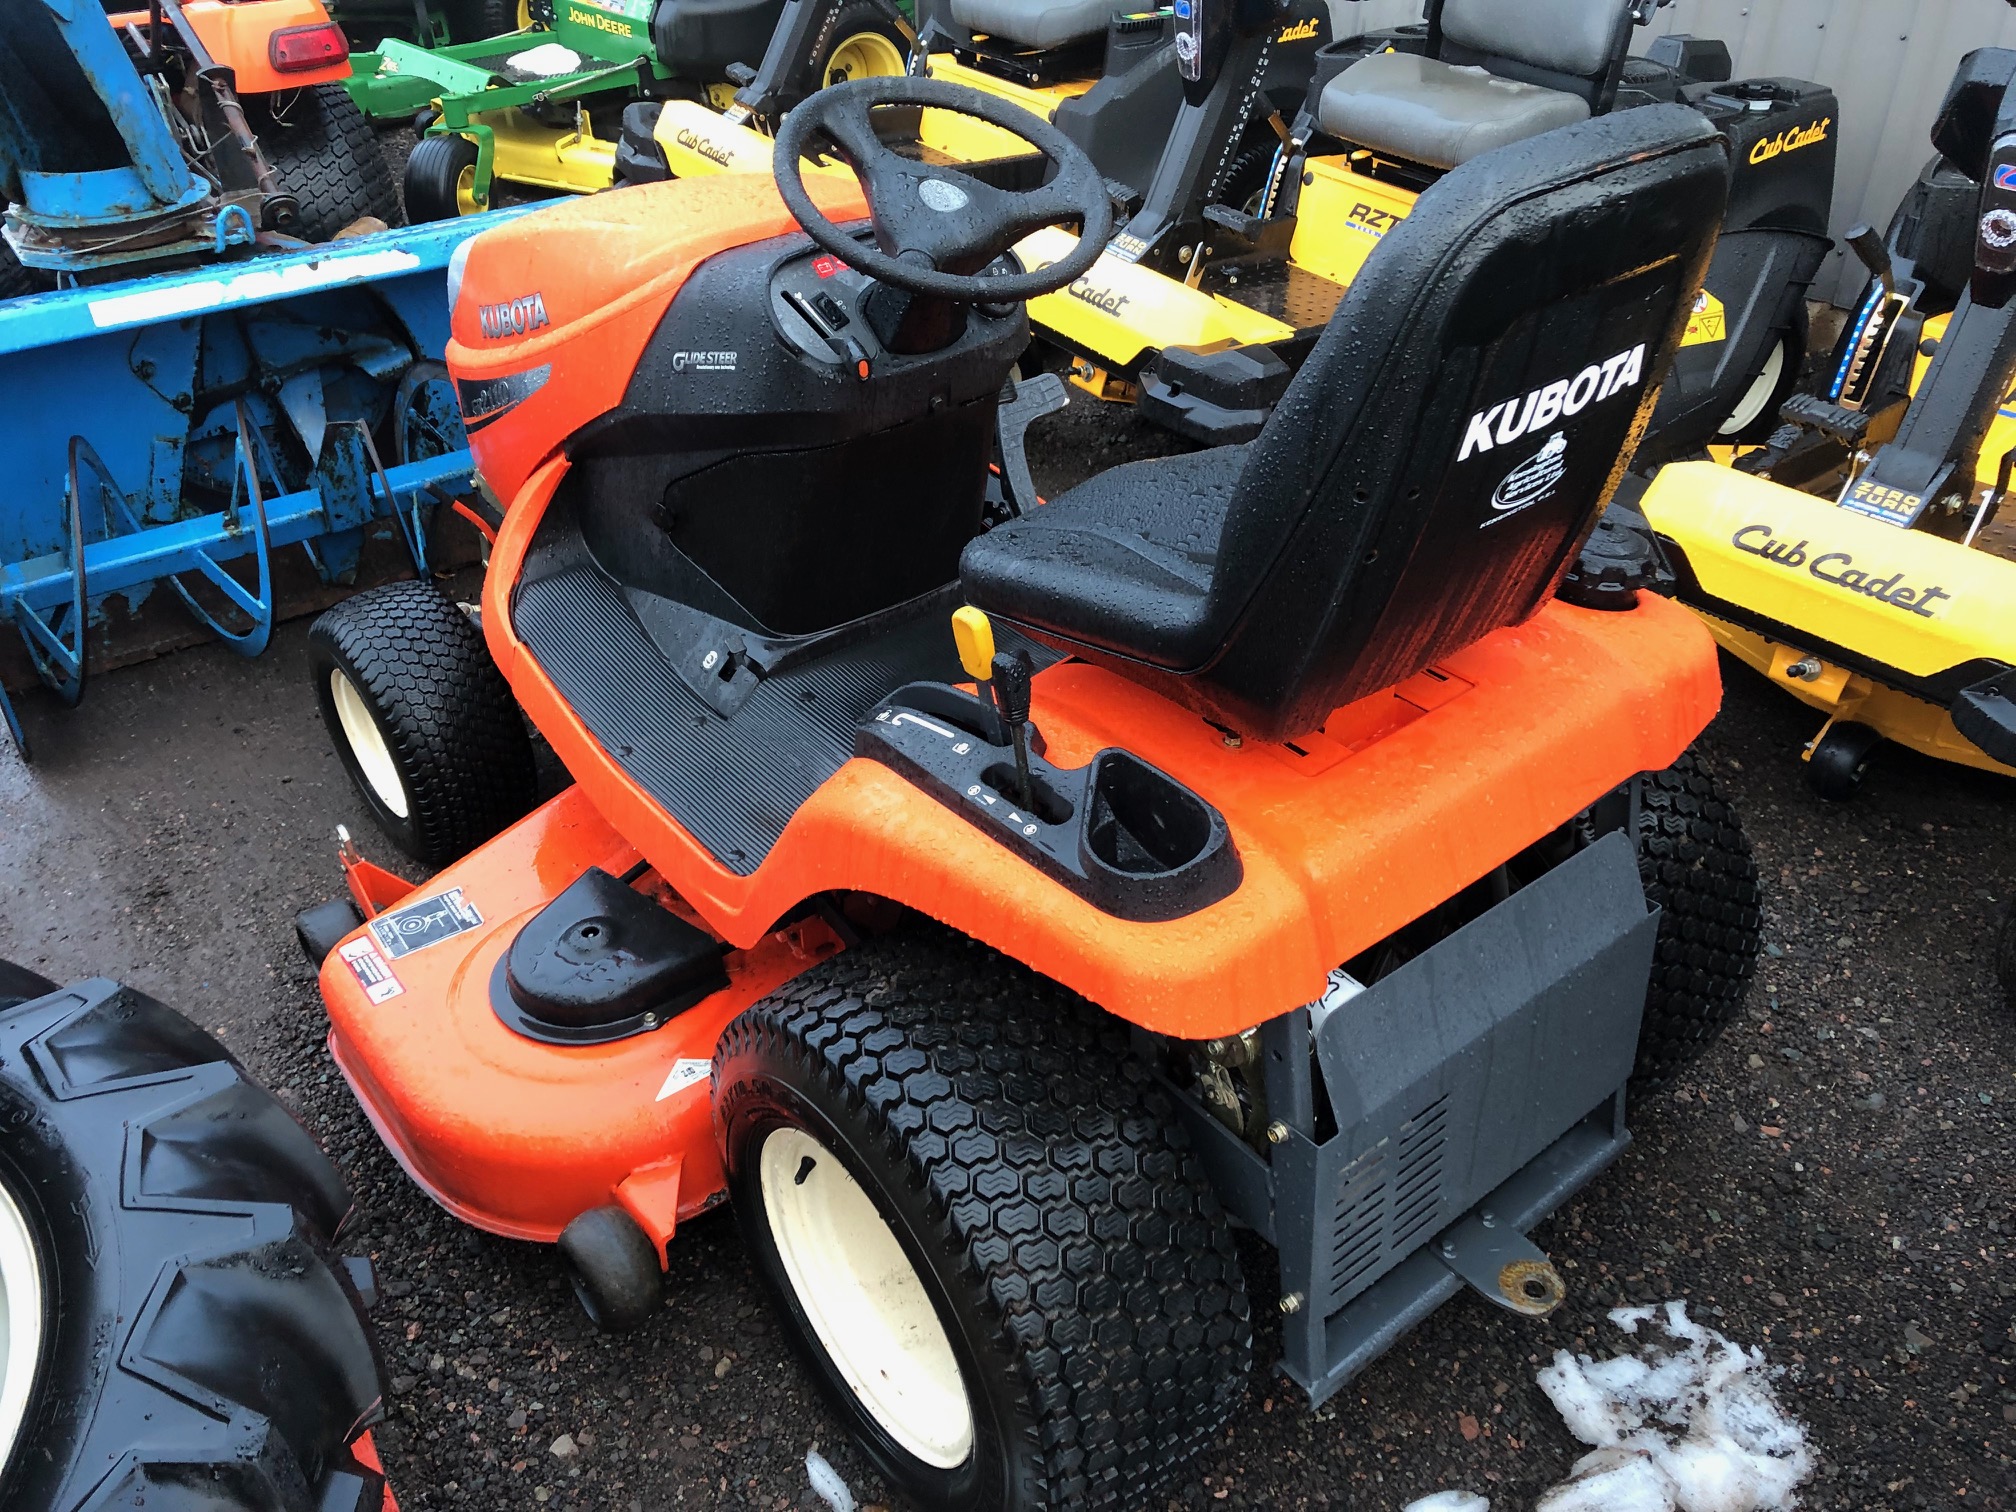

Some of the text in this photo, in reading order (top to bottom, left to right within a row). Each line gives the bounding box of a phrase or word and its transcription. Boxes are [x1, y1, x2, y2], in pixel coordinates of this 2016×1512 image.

[569, 6, 596, 28] JOHN
[596, 13, 633, 39] DEERE
[808, 8, 835, 66] COLONNE
[1277, 17, 1320, 43] adet
[677, 128, 734, 167] Cub Cadet
[1207, 125, 1239, 198] COLONNE
[1240, 94, 1251, 115] DE
[1749, 117, 1831, 165] Cub Cadet
[1348, 202, 1404, 231] RZT
[1113, 238, 1144, 256] TURN
[479, 291, 550, 339] KUBOTA
[1068, 276, 1130, 318] Cadet
[1456, 343, 1646, 463] KUBOTA
[1854, 490, 1916, 515] TURN
[1855, 481, 1921, 506] ZERO
[1732, 524, 1951, 618] Cub Cadet
